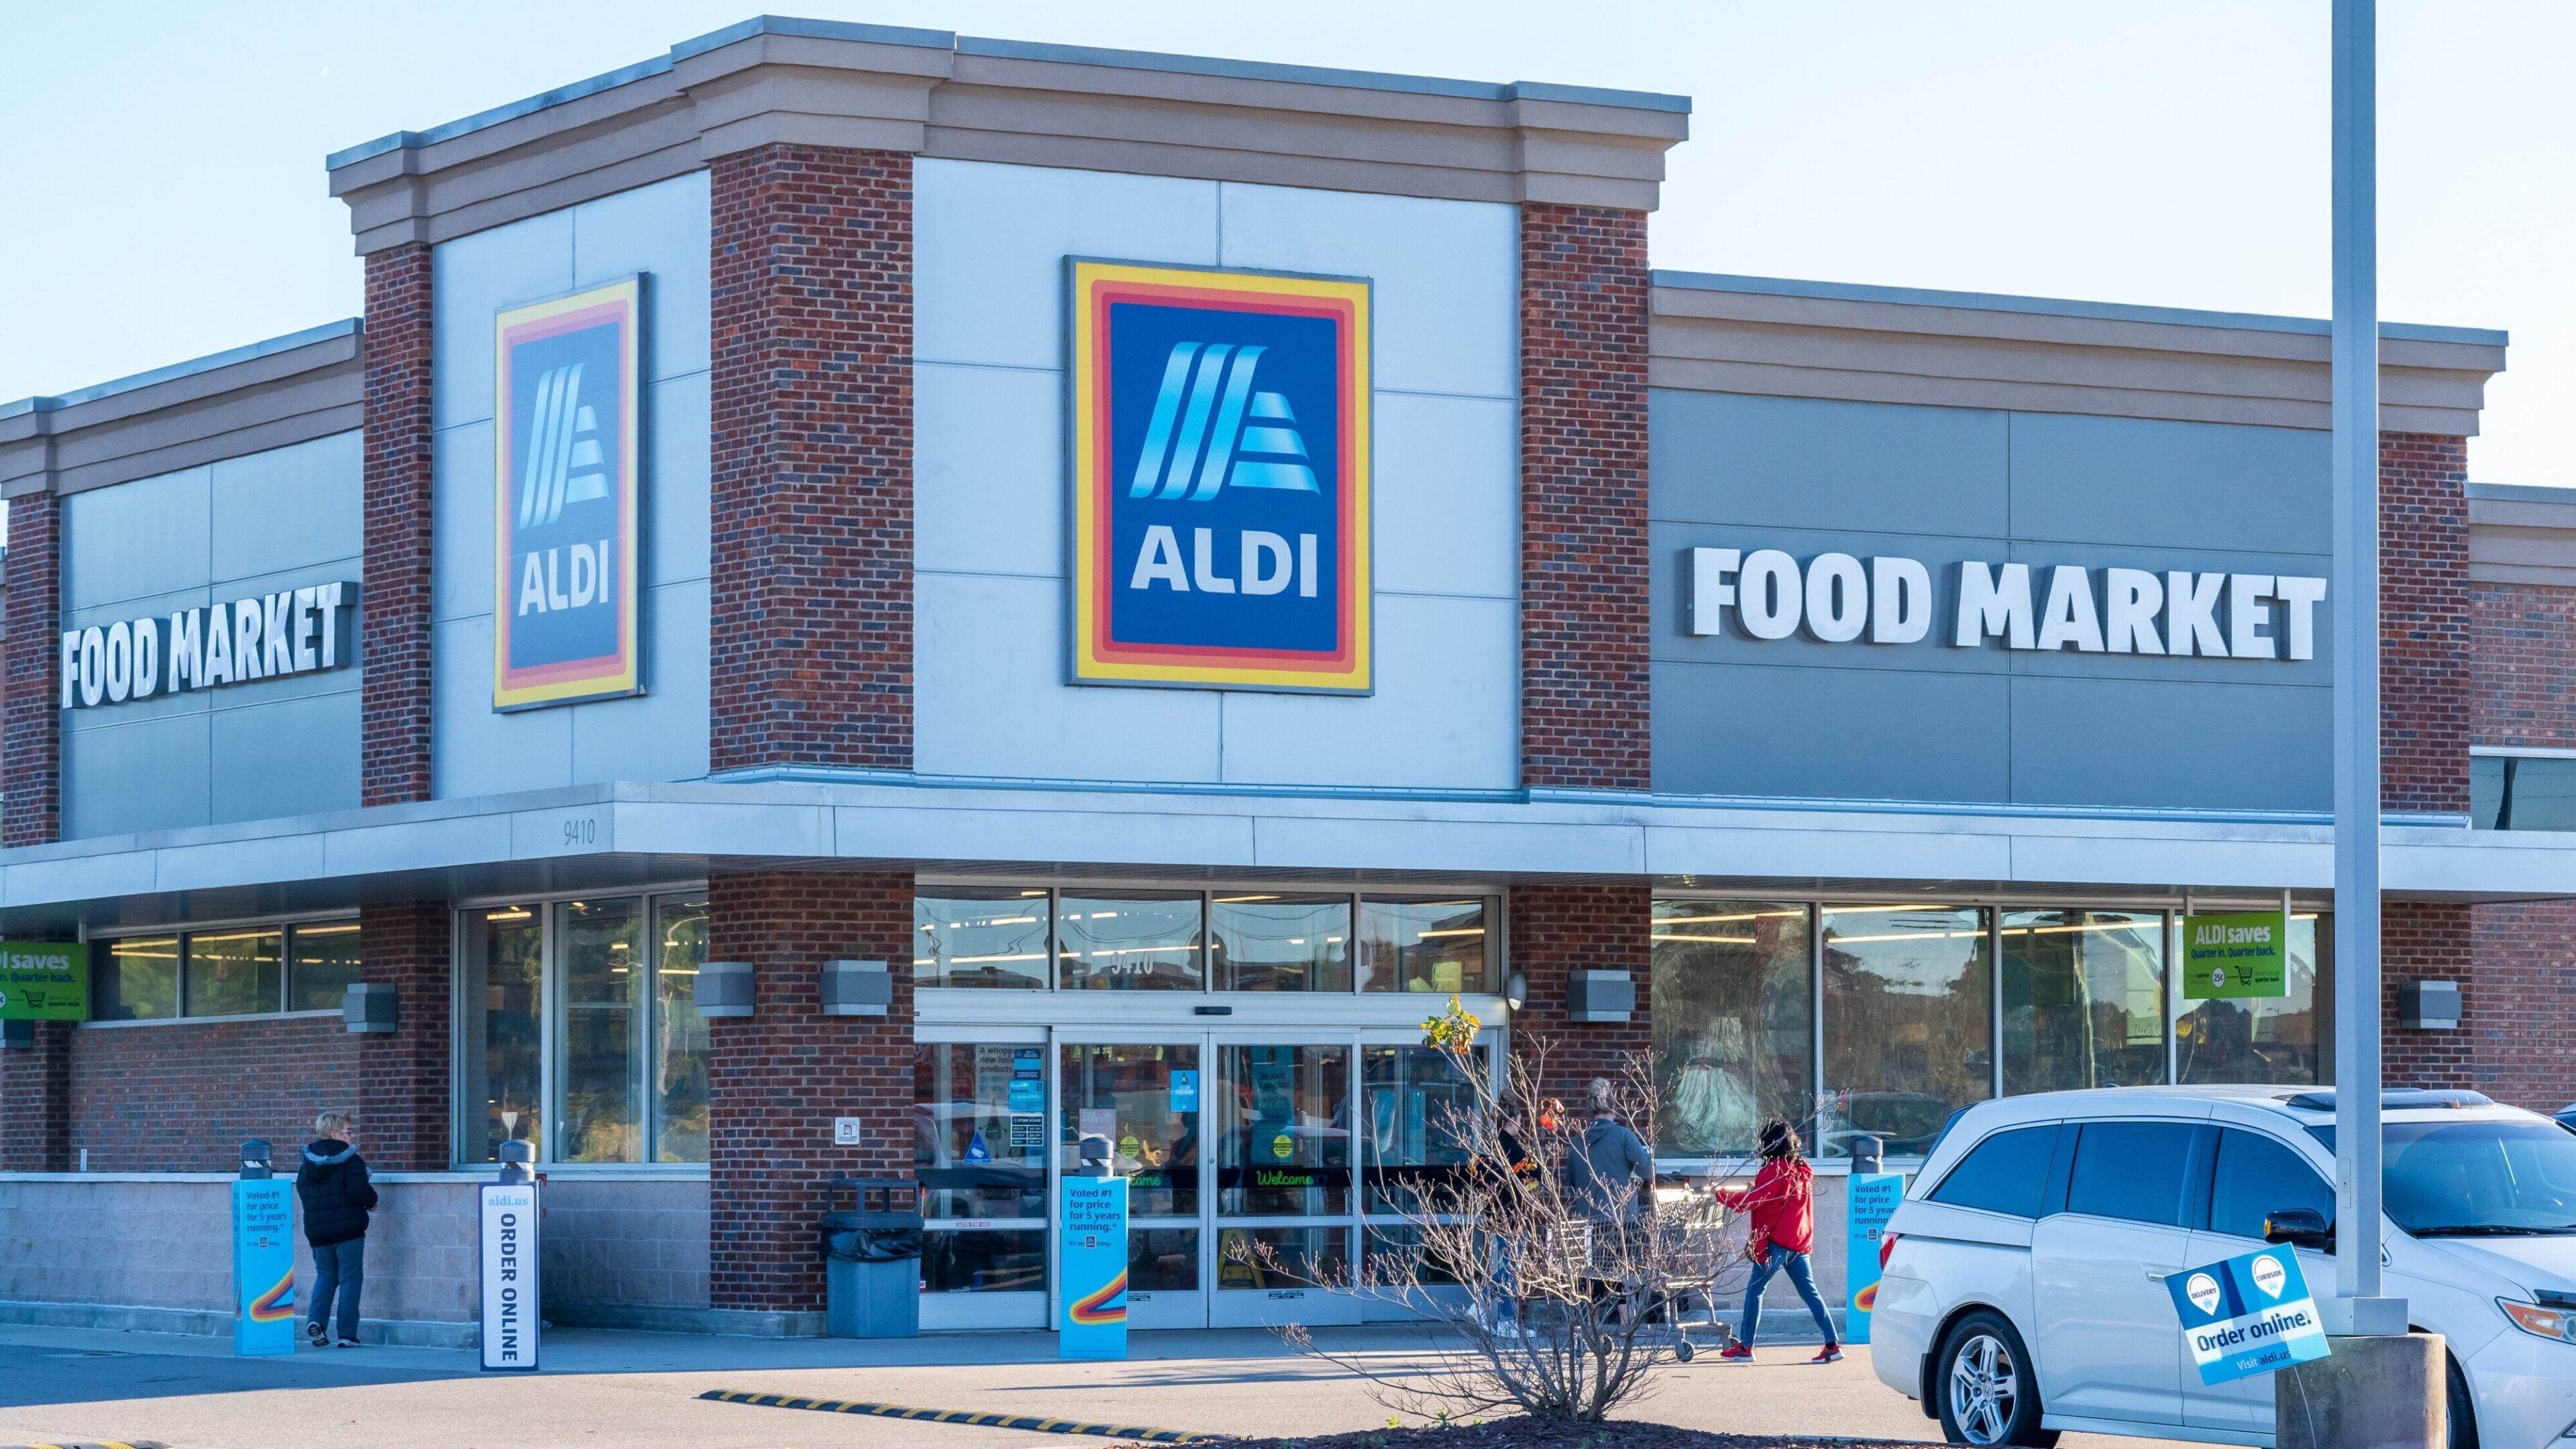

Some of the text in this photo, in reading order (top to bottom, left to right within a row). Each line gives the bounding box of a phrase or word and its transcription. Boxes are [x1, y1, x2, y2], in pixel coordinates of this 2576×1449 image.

[1130, 525, 1317, 598] ALDI
[519, 539, 608, 616] ALDI
[1690, 547, 2327, 660] FOOD MARKET
[62, 582, 343, 708] FOOD MARKET
[564, 819, 595, 845] 9410
[2195, 925, 2271, 945] ALDI saves
[2191, 945, 2276, 960] Quarter in. Quarter back.
[11, 955, 69, 970] saves
[1111, 951, 1153, 974] 9410
[11, 973, 48, 983] Quarter
[980, 1065, 1012, 1073] products
[1256, 1171, 1313, 1185] Welcome
[247, 1191, 269, 1199] Voted
[1070, 1189, 1112, 1197] Voted #1
[260, 1201, 279, 1212] price
[488, 1195, 529, 1207] aldi.us
[1070, 1200, 1110, 1210] for price
[1855, 1195, 1890, 1205] for price
[266, 1214, 287, 1224] years
[1070, 1211, 1121, 1224] for 5 years
[1876, 1208, 1896, 1218] year
[1855, 1216, 1889, 1226] running
[2256, 1269, 2282, 1282] CURBSIDE
[500, 1214, 517, 1361] ORDER ONLINE
[2191, 1287, 2216, 1299] DELIVERY
[2196, 1311, 2312, 1352] Order online.
[2236, 1350, 2292, 1371] Visit aldi.us
